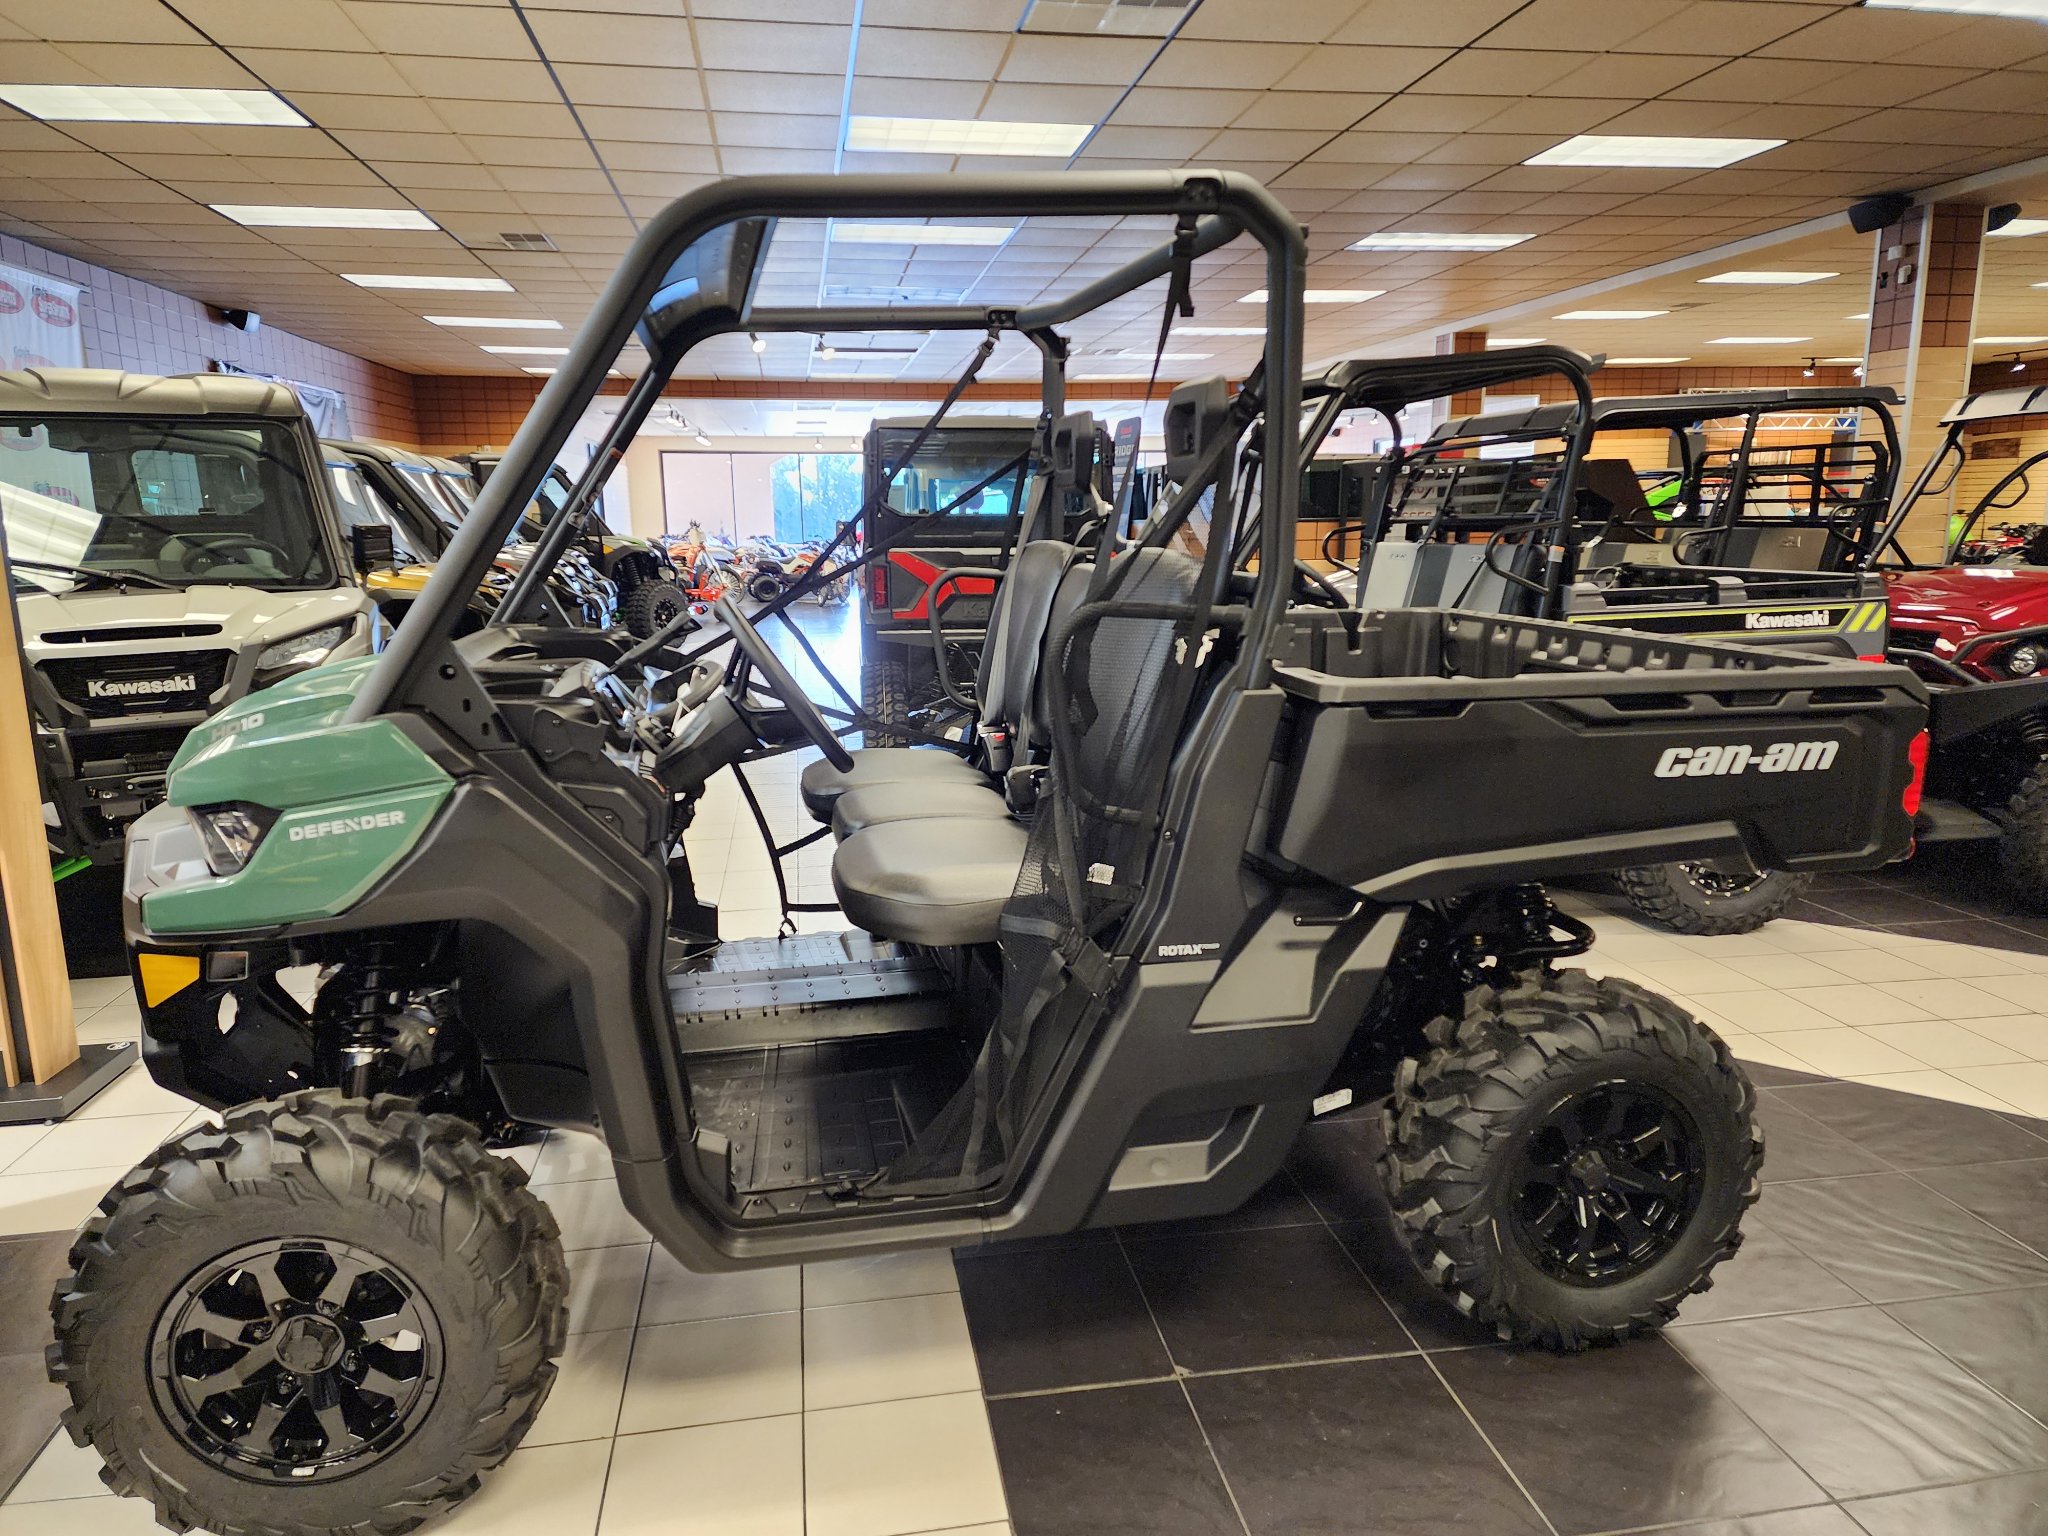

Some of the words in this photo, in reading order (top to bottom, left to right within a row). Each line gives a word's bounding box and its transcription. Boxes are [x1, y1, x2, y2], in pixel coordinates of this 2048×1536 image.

[1745, 610, 1830, 629] Kawasaki
[87, 675, 196, 697] Kawasaki
[1654, 740, 1839, 778] can-am
[289, 810, 405, 841] DEFENDER
[1158, 944, 1203, 957] ROTAX
